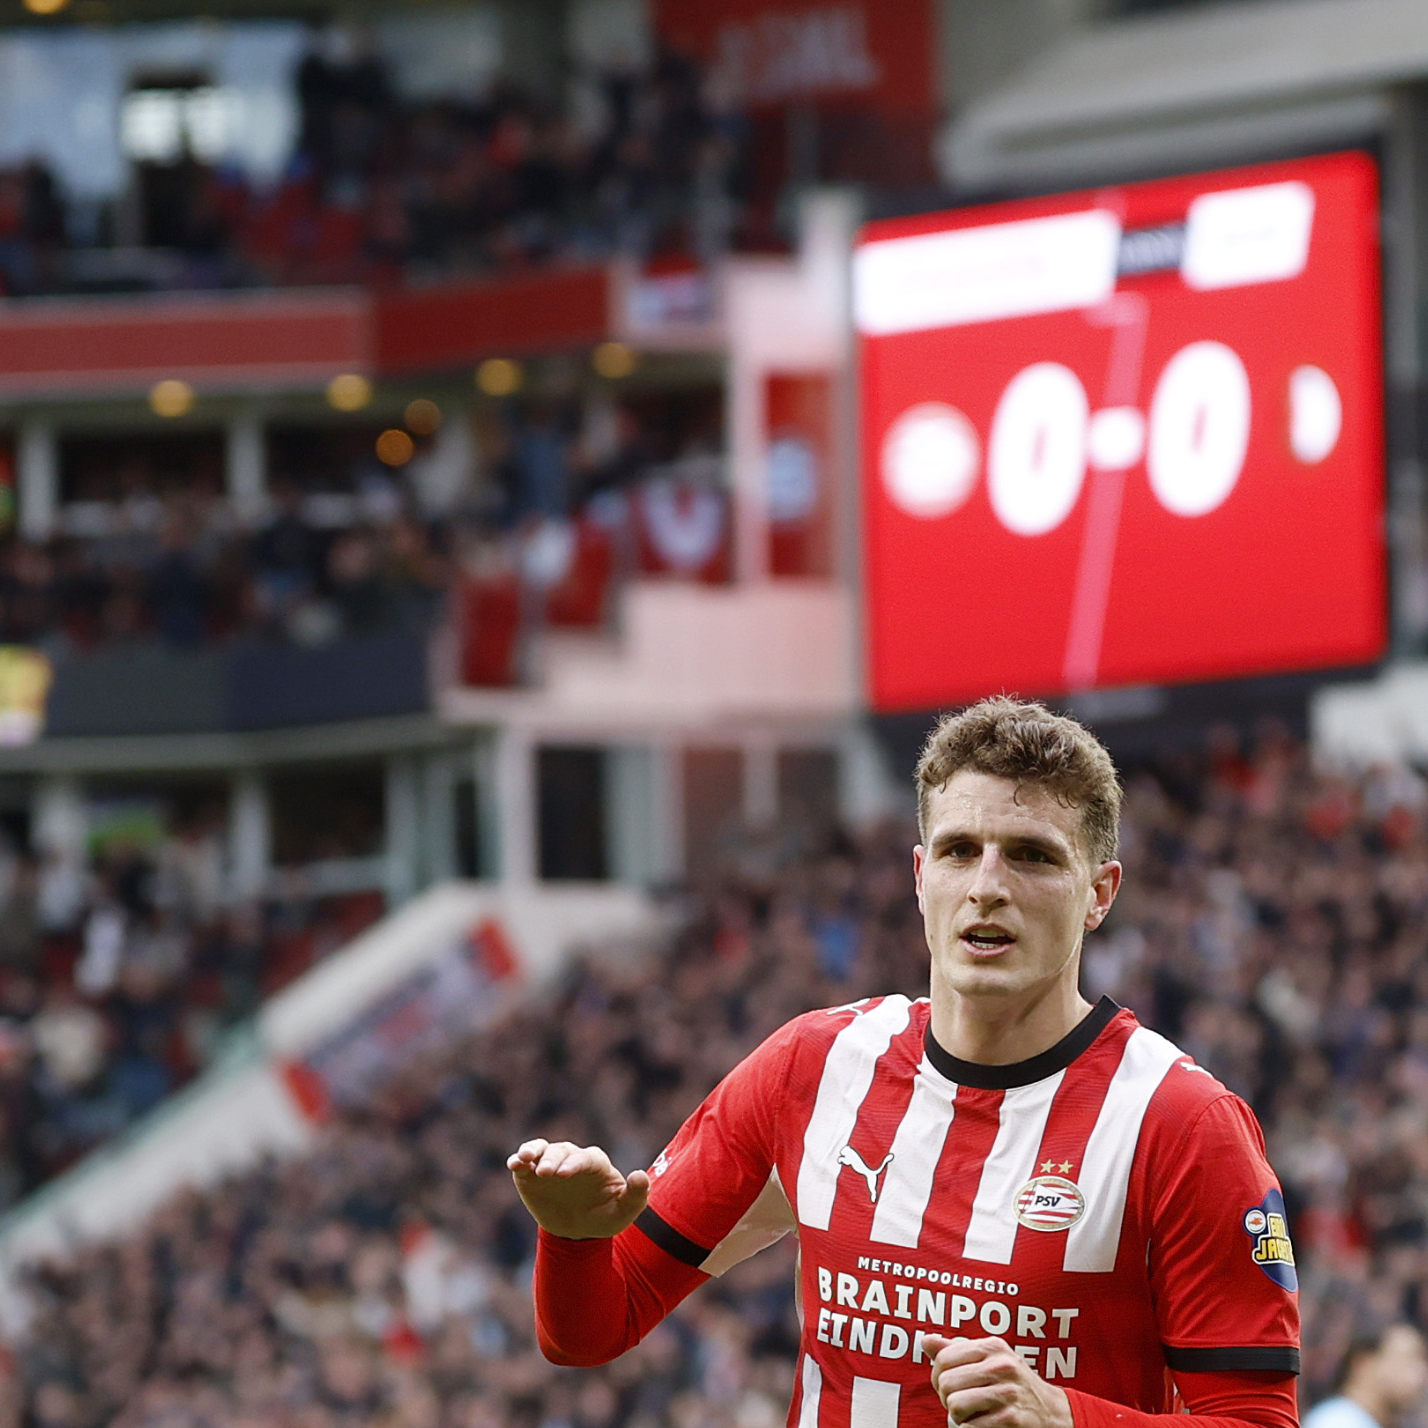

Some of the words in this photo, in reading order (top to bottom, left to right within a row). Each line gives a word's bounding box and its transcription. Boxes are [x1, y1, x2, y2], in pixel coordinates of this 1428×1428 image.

[1035, 1195, 1061, 1207] PSV
[817, 1265, 1080, 1340] BRAINPORT
[857, 1255, 1020, 1297] METROPOOLREGIO
[816, 1307, 1078, 1380] EINDHEN
